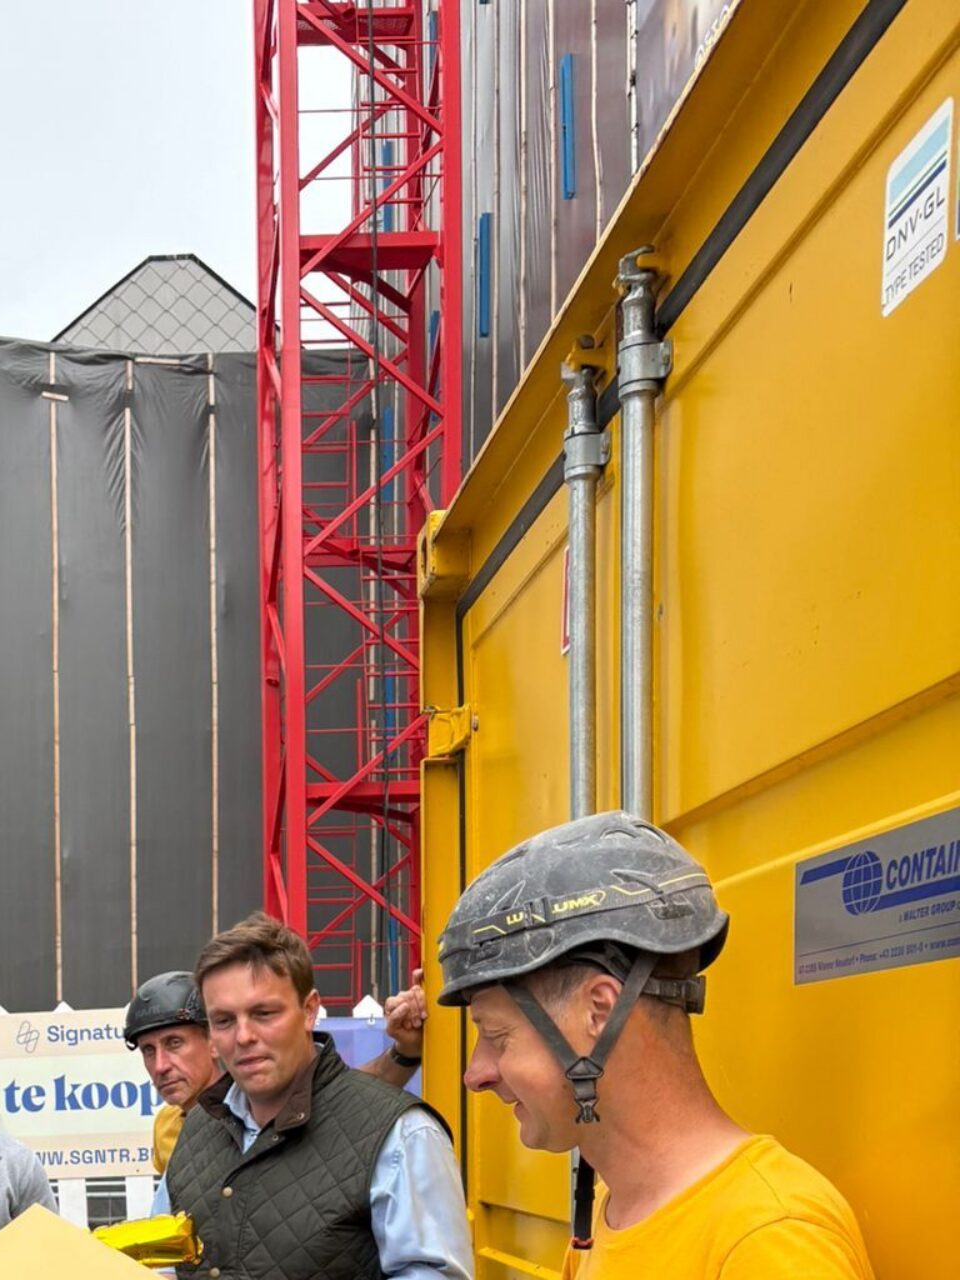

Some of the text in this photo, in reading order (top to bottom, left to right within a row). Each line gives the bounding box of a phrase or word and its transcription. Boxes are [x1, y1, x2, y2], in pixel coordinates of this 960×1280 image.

[907, 232, 944, 280] TESTED
[47, 1023, 125, 1046] Signatu
[4, 1075, 162, 1116] te koop
[34, 1148, 155, 1166] WW.SGNTR.B
